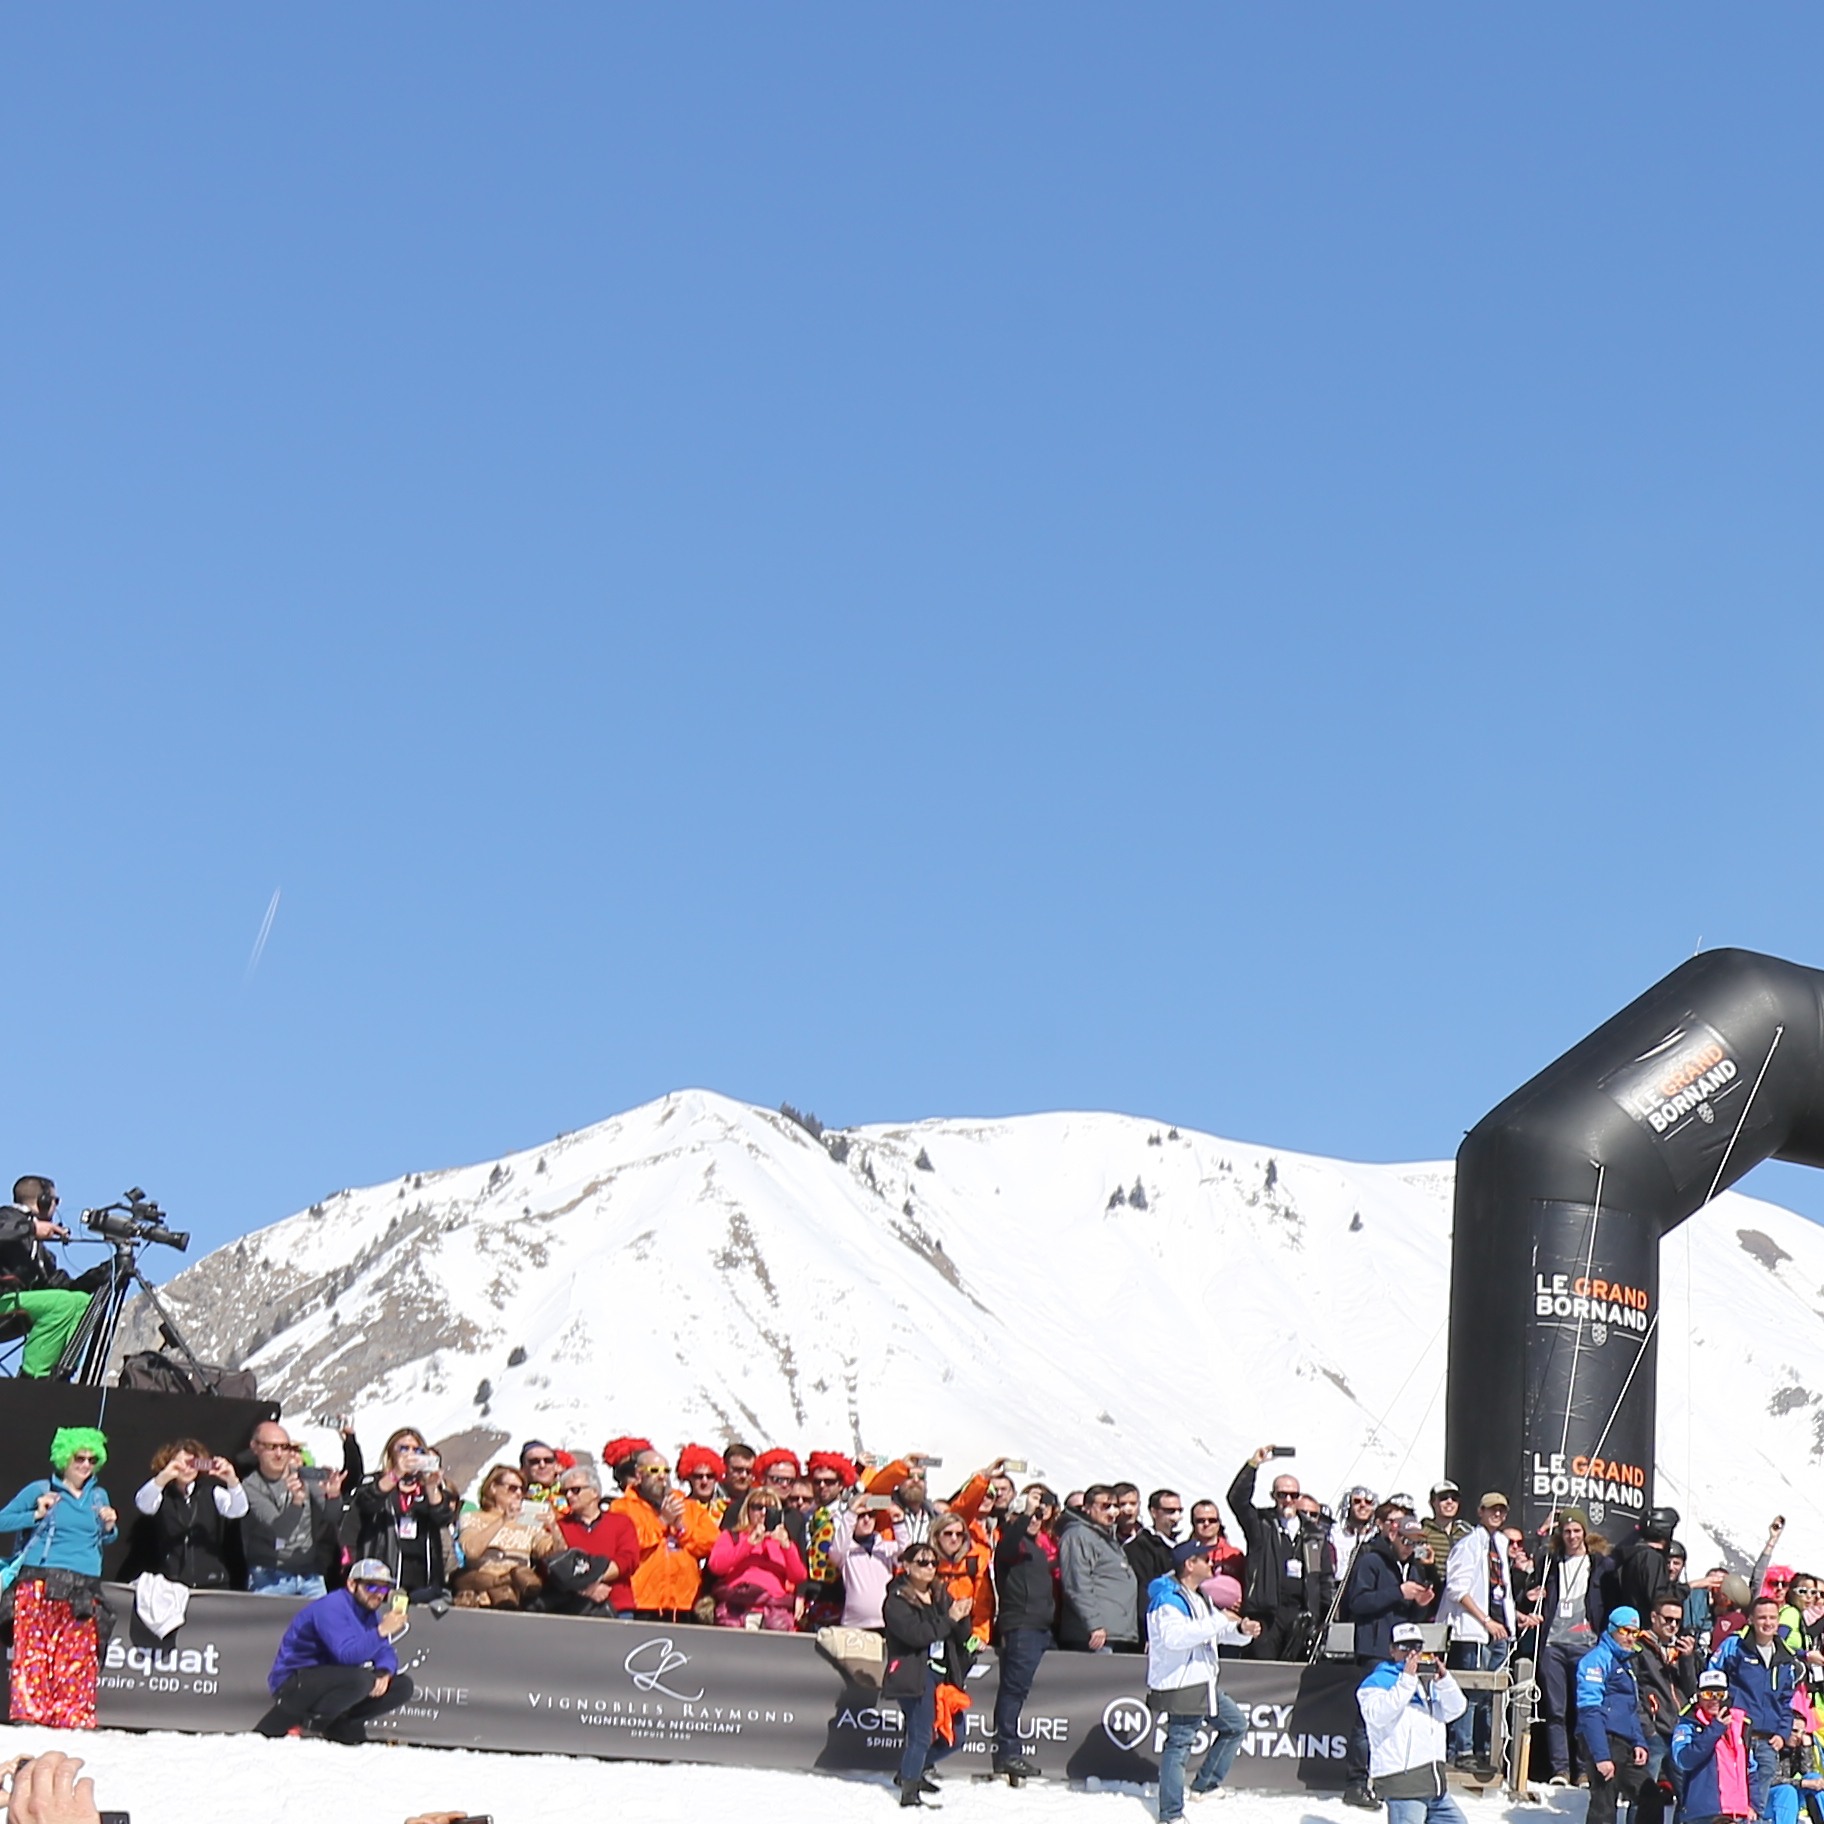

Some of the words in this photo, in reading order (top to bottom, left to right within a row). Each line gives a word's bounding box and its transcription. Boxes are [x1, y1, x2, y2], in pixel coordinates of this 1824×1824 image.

[1633, 1091, 1666, 1116] LE
[1658, 1044, 1725, 1098] GRAND
[1649, 1059, 1738, 1134] BORNAND
[1536, 1273, 1569, 1294] LE
[1574, 1277, 1647, 1310] GRAND
[1536, 1295, 1647, 1331] BORNAND
[1534, 1453, 1566, 1474] LE
[1571, 1455, 1645, 1488] GRAND
[1533, 1474, 1645, 1509] BORNAND
[105, 1637, 219, 1676] équat
[149, 1677, 181, 1693] CDD
[193, 1678, 219, 1695] CDI
[400, 1705, 439, 1720] Annecy
[528, 1692, 664, 1716] VIGNOBLES
[683, 1703, 796, 1725] RAYMOND
[965, 1713, 1069, 1741] FUURE
